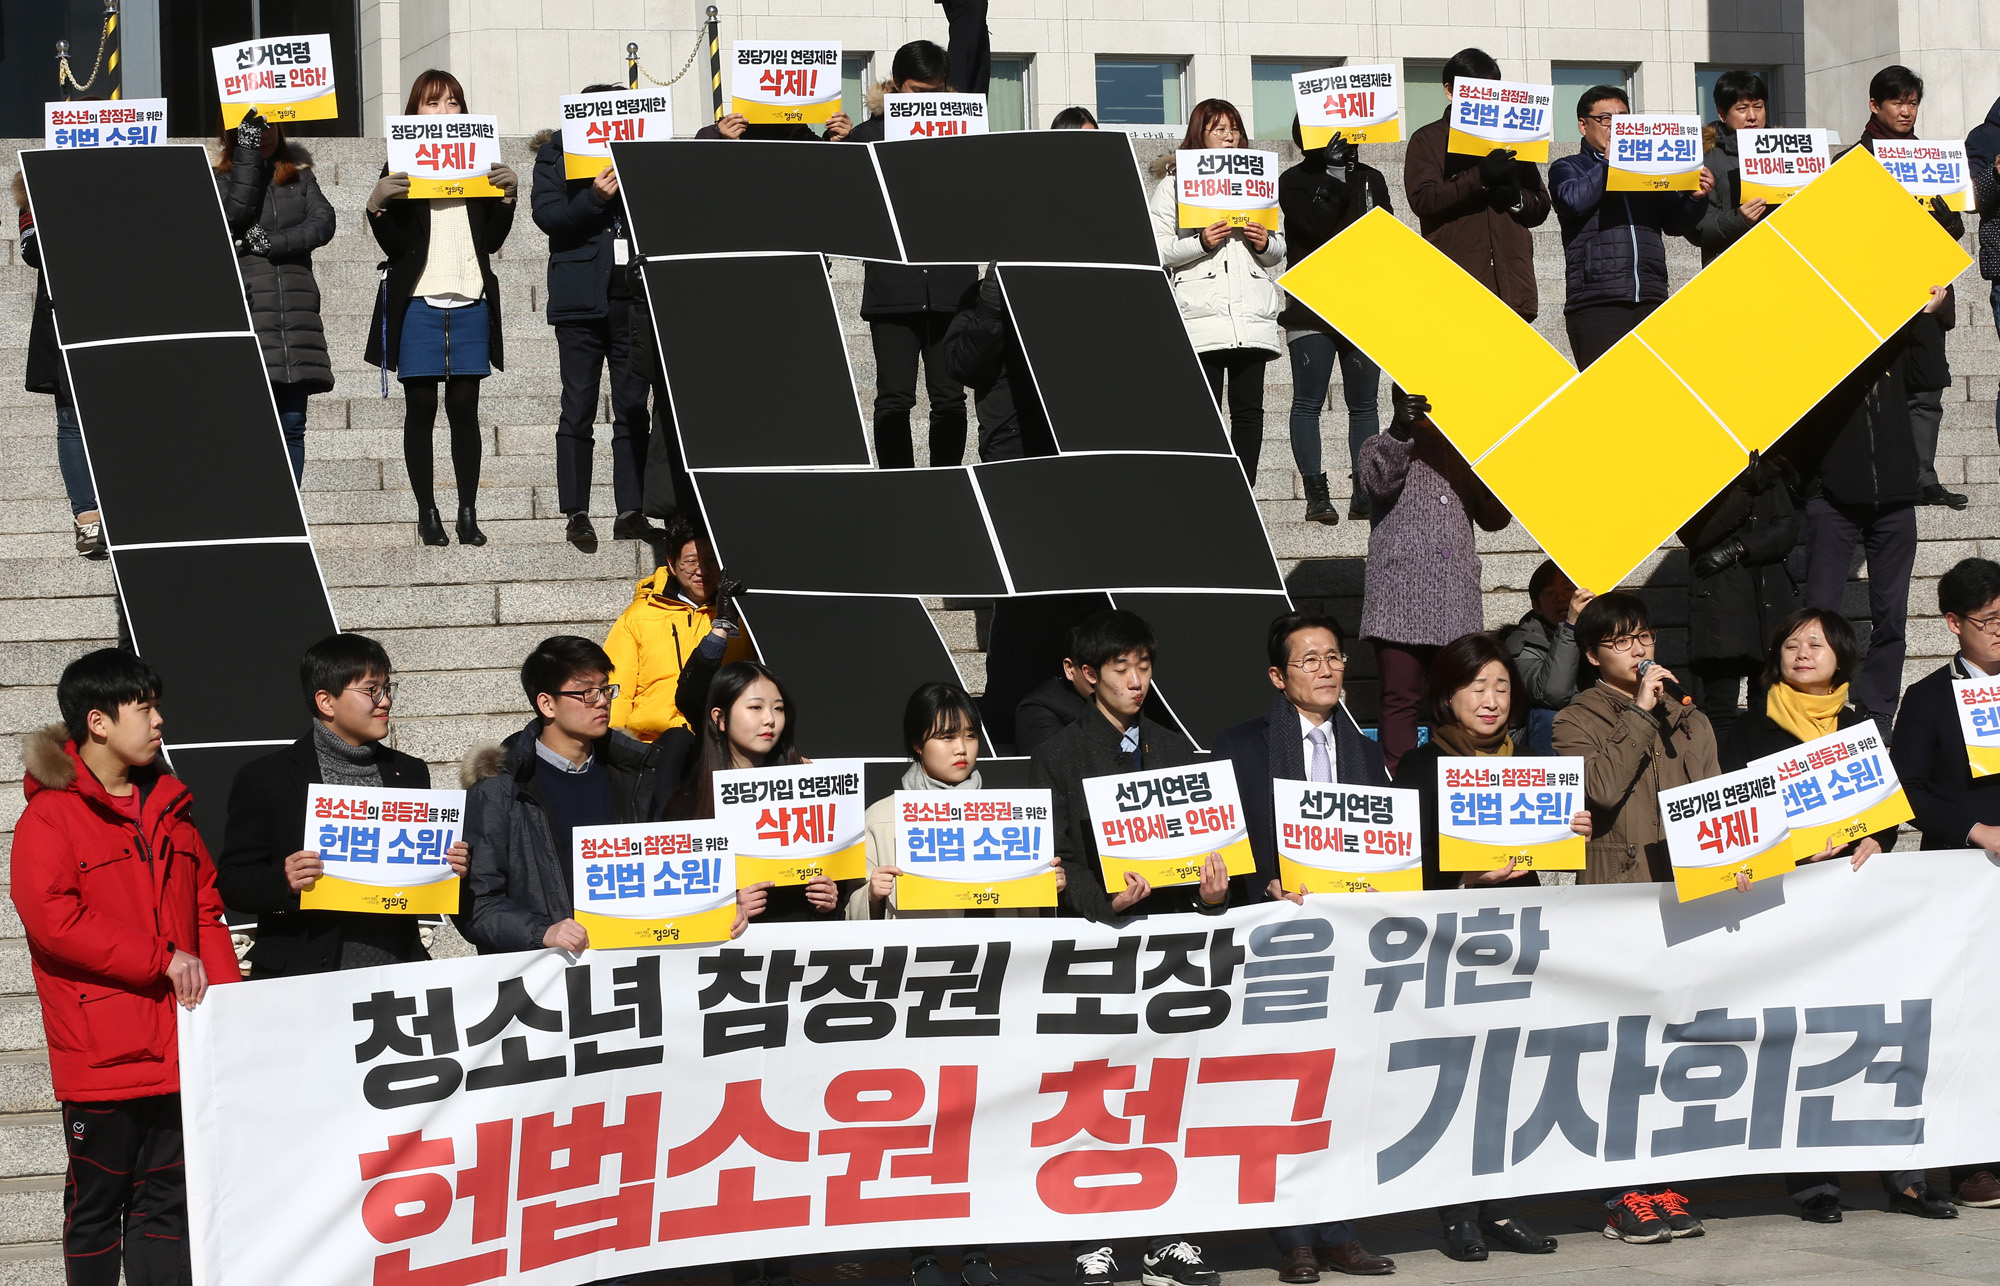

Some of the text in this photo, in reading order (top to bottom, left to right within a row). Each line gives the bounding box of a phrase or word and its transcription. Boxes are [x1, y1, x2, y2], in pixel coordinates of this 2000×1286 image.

[236, 42, 311, 70] 선거연령
[738, 50, 838, 65] 정당가입 연령제한
[224, 67, 326, 96] 만18세로 인하!
[760, 70, 818, 96] 삭제!
[1298, 72, 1392, 95] 정당가입 연령제한
[564, 97, 666, 119] 정당가입 연령제한
[1324, 92, 1374, 118] 삭제!
[1459, 85, 1550, 106] 청소년의 참정권을 위한
[52, 109, 163, 125] 청소년의 참정권을 위한
[890, 102, 983, 117] 정당가입 연령제한
[1460, 101, 1544, 131] 헌법 소원!
[392, 124, 494, 139] 정당가입 연령제한
[1616, 122, 1698, 135] 청소년의 선거권을 위한
[416, 142, 476, 170] 삭제!
[1618, 139, 1696, 162] 헌법 소원!
[1755, 134, 1813, 154] 선거연령
[1878, 147, 1912, 158] 청소년의
[1197, 154, 1264, 176] 선거연령
[1745, 157, 1825, 174] 만18세로 인하!
[1922, 163, 1960, 183] 소원!
[1184, 178, 1274, 199] 만18세로 인하!
[1807, 742, 1858, 770] 평등권을
[1858, 736, 1878, 752] 위한
[721, 773, 860, 804] 정당가입 연령제한
[1446, 768, 1579, 788] 청소년의 참정권을 위한
[1828, 755, 1885, 801] 소원!
[1116, 772, 1212, 812] 선거연령
[1666, 775, 1776, 822] 정당가입 연령제한
[315, 796, 460, 822] 청소년의 평등권을 위한
[902, 802, 1047, 822] 청소년의 참정권을 위한
[1300, 790, 1394, 824] 선거연령
[1450, 792, 1572, 826] 헌법 소원!
[756, 803, 836, 846] 삭제!
[1102, 804, 1236, 846] 만18세로 인하!
[1697, 807, 1758, 854] 삭제!
[1845, 823, 1868, 837] 정의당
[319, 824, 454, 865] 헌법 소원!
[580, 834, 728, 859] 청소년의 참정권을 위한
[908, 826, 1041, 862] 헌법 소원!
[1283, 823, 1412, 856] 만18세로 인하!
[586, 858, 722, 900] 헌법 소원!
[382, 897, 408, 910] 정의당
[973, 893, 1000, 904] 정의당
[653, 928, 680, 941] 정의당
[352, 906, 1550, 1110] 청소년 참정권 보장을 위한
[358, 998, 1932, 1286] 헌법소원 청구 기자회견
